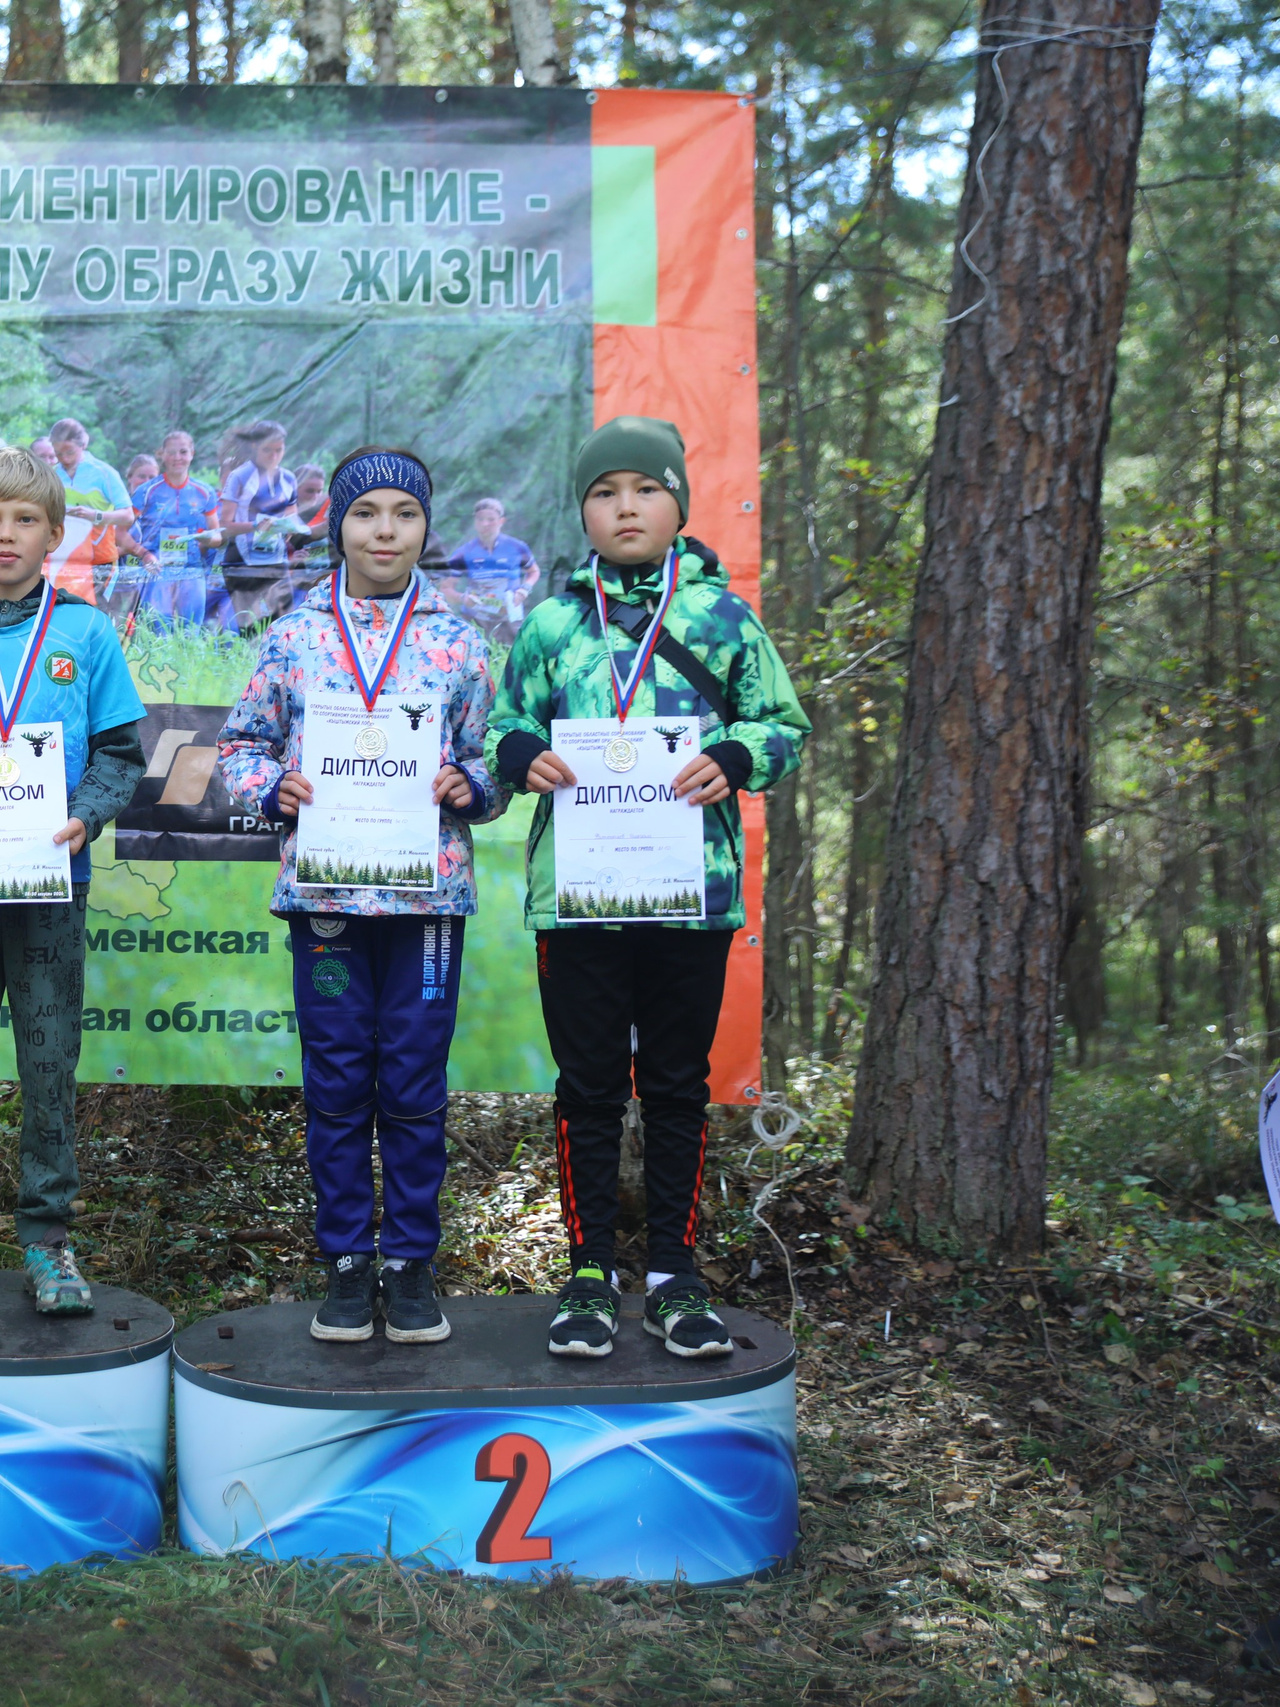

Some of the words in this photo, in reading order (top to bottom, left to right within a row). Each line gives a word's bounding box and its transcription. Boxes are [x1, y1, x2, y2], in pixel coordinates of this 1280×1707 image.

[525, 194, 550, 212] -
[73, 246, 318, 304] ОБРАЗУ
[339, 247, 561, 307] ЖИЗНИ
[320, 758, 417, 777] ДИПЛОМ
[574, 784, 678, 806] ДИПЛОМ
[423, 924, 436, 985] СПОРТИВНОЕ
[422, 986, 445, 1000] ЮГРА
[336, 1255, 352, 1268] alo
[474, 1432, 553, 1563] 2
